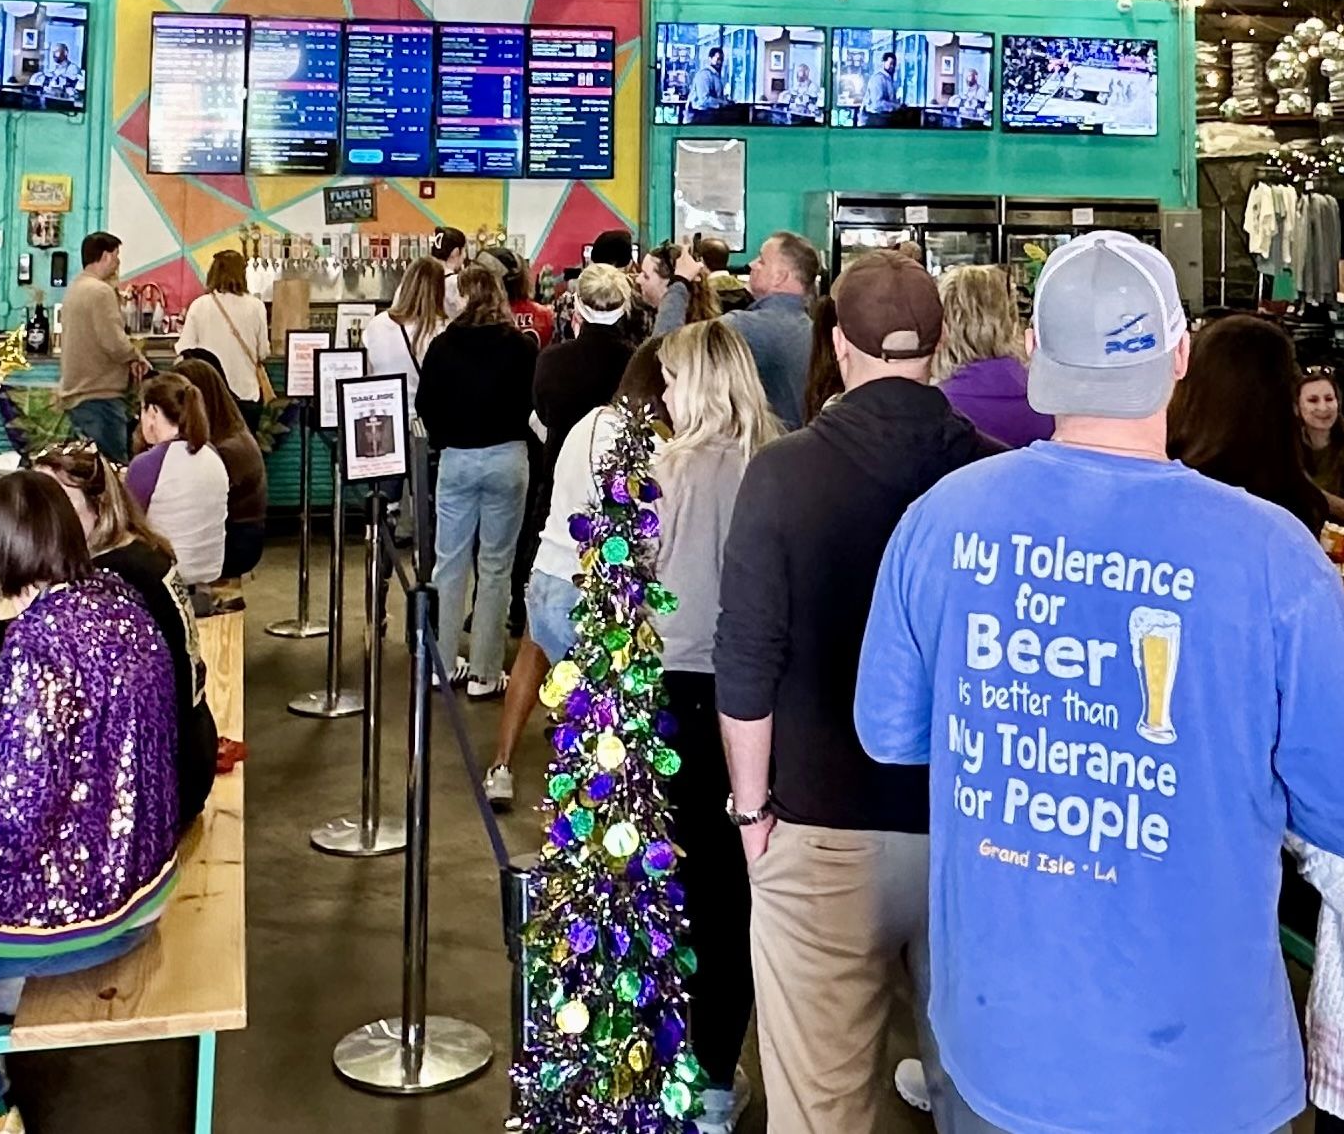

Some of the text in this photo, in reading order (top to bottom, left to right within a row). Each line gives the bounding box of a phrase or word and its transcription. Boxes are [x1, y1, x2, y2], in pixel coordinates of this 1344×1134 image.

[953, 531, 1195, 601] My Tolerance
[1014, 582, 1066, 625] for
[966, 613, 1118, 687] Beer
[958, 676, 1119, 730] is better than
[996, 723, 1178, 797] Tolerance
[1002, 777, 1170, 854] People
[978, 838, 1118, 884] Grand Isle LA
